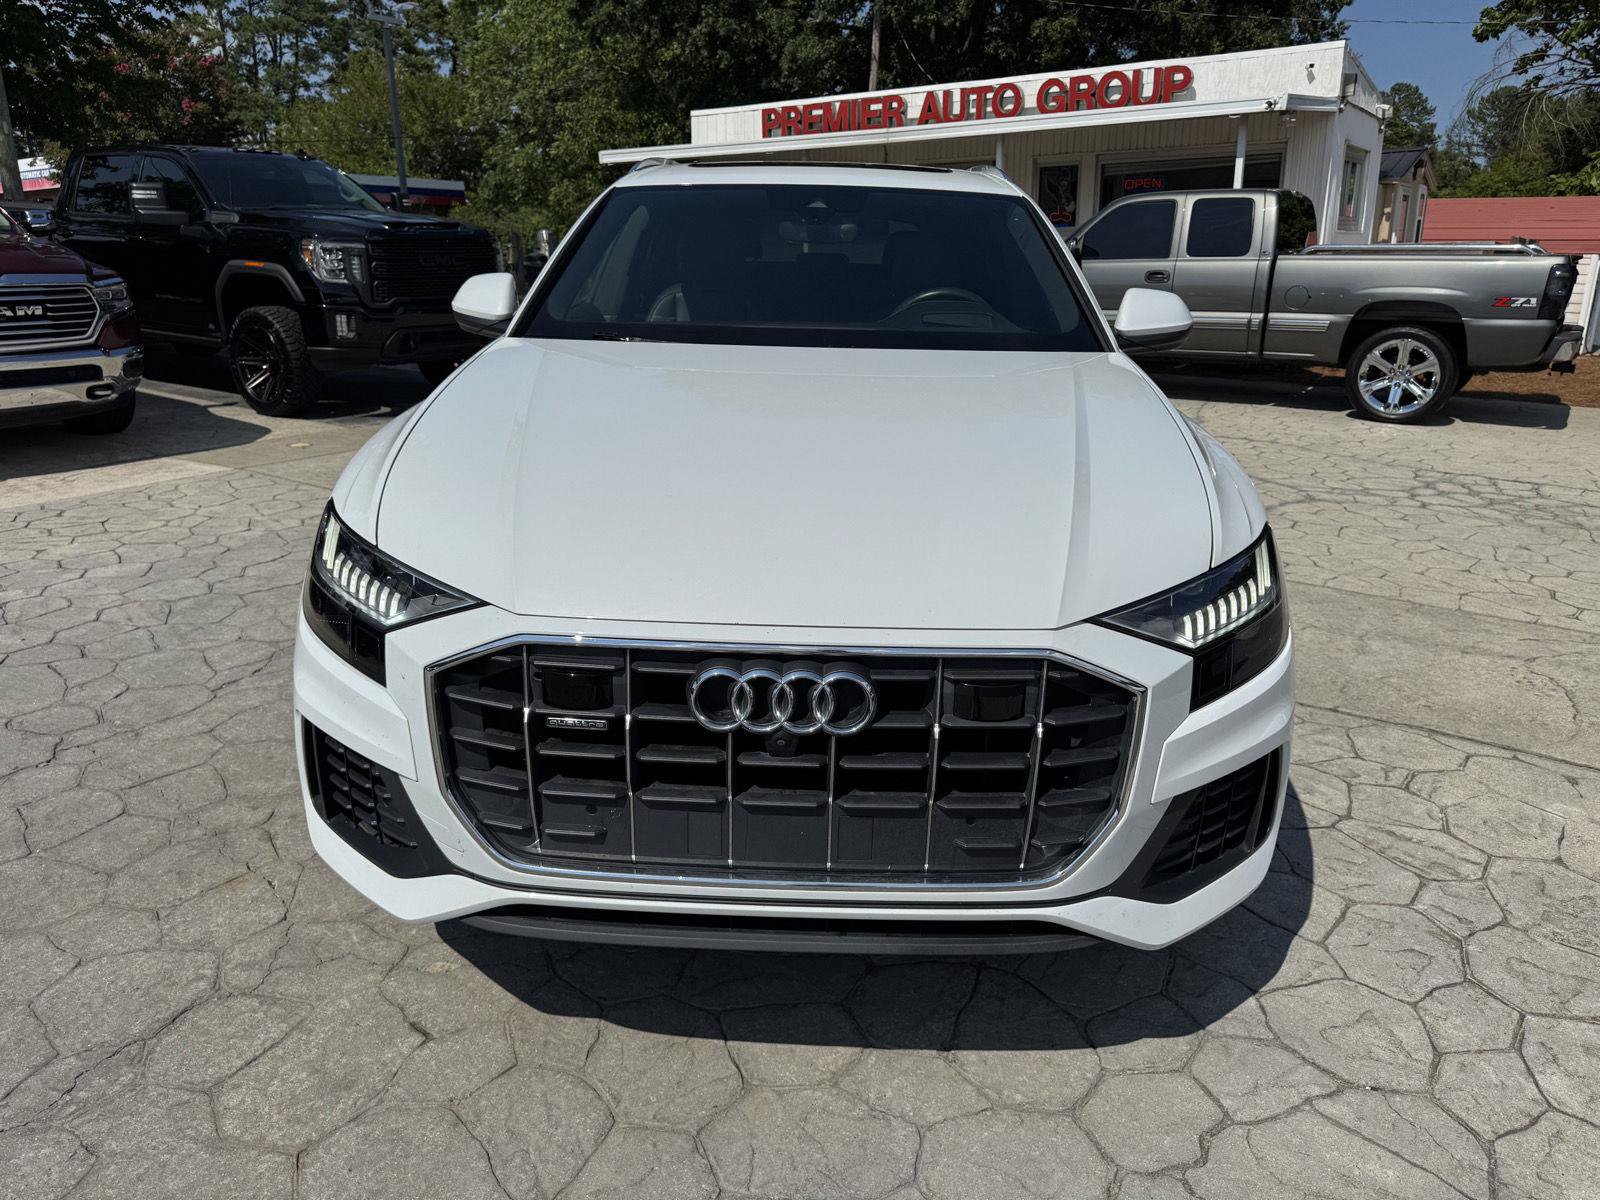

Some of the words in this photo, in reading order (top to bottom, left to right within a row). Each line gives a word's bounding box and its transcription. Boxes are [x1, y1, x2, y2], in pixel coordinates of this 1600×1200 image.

[762, 95, 904, 138] PREMIER
[917, 83, 1023, 125] AUTO
[1037, 65, 1194, 115] GROUP
[1124, 178, 1162, 189] OPEN
[418, 254, 464, 266] GMC
[1490, 296, 1537, 306] Z71
[0, 305, 43, 316] AM
[548, 718, 605, 728] quattro
